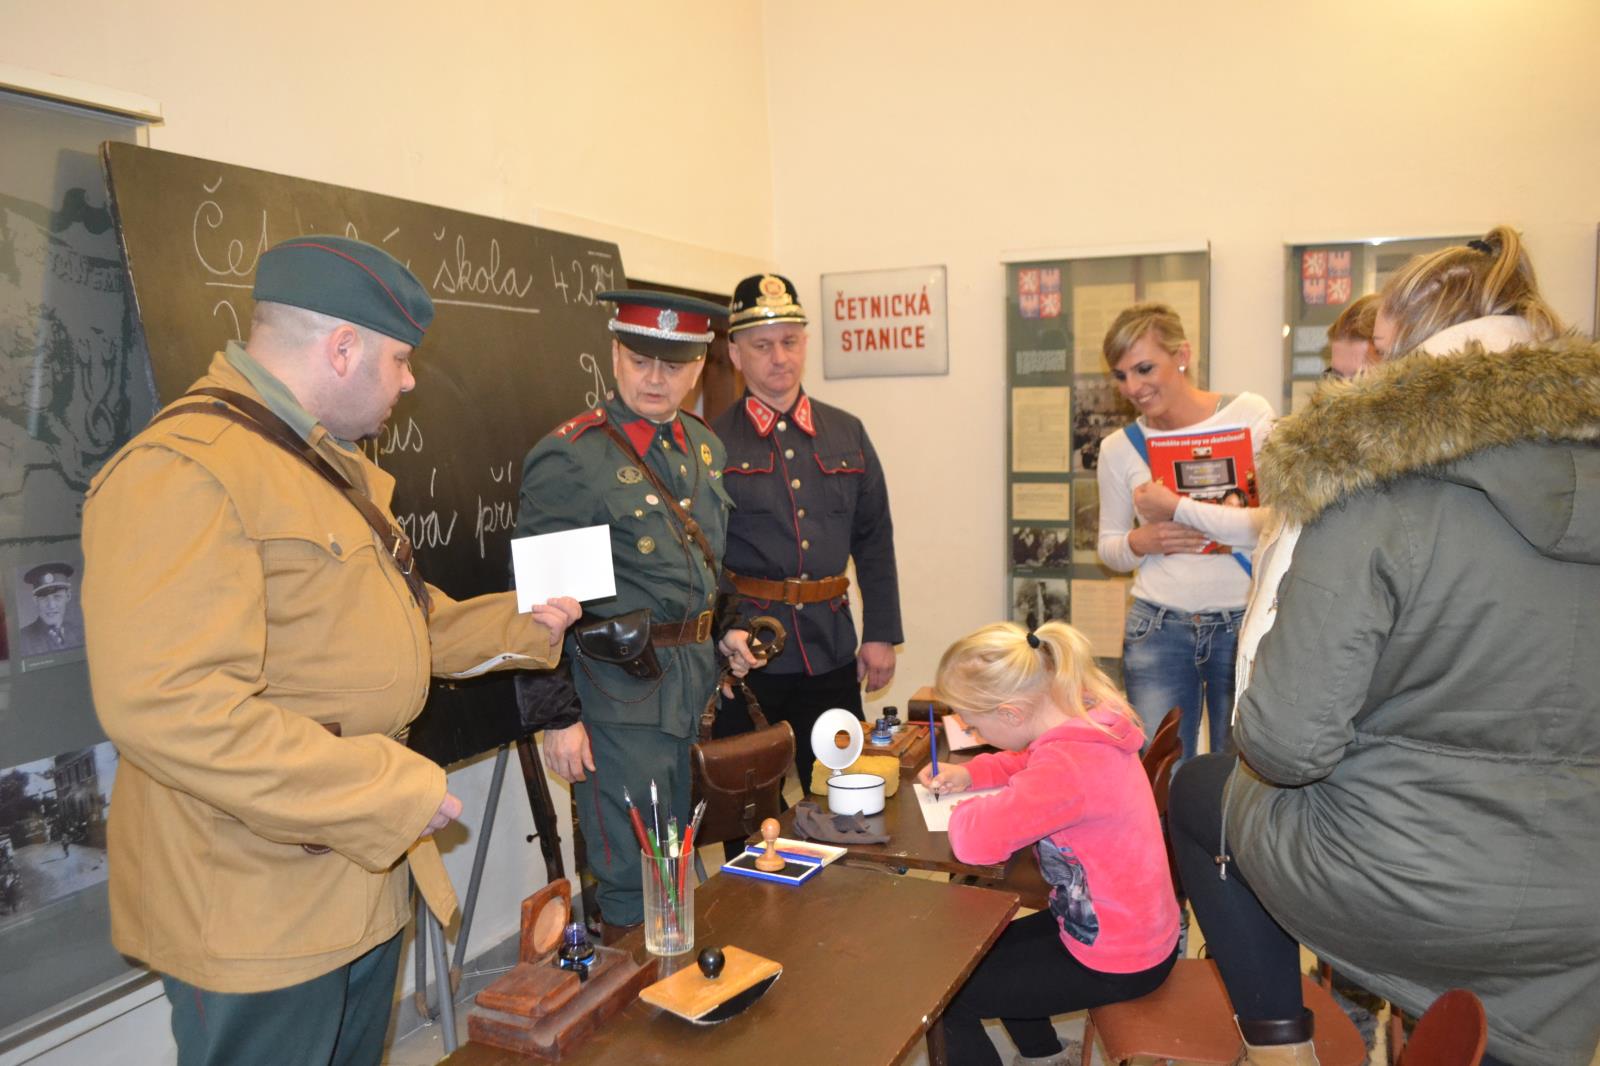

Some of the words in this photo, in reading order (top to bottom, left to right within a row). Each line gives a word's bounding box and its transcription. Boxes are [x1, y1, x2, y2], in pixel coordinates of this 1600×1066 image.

[433, 226, 533, 298] škola
[835, 284, 931, 320] ČETNICKÁ
[841, 325, 926, 353] STANICE
